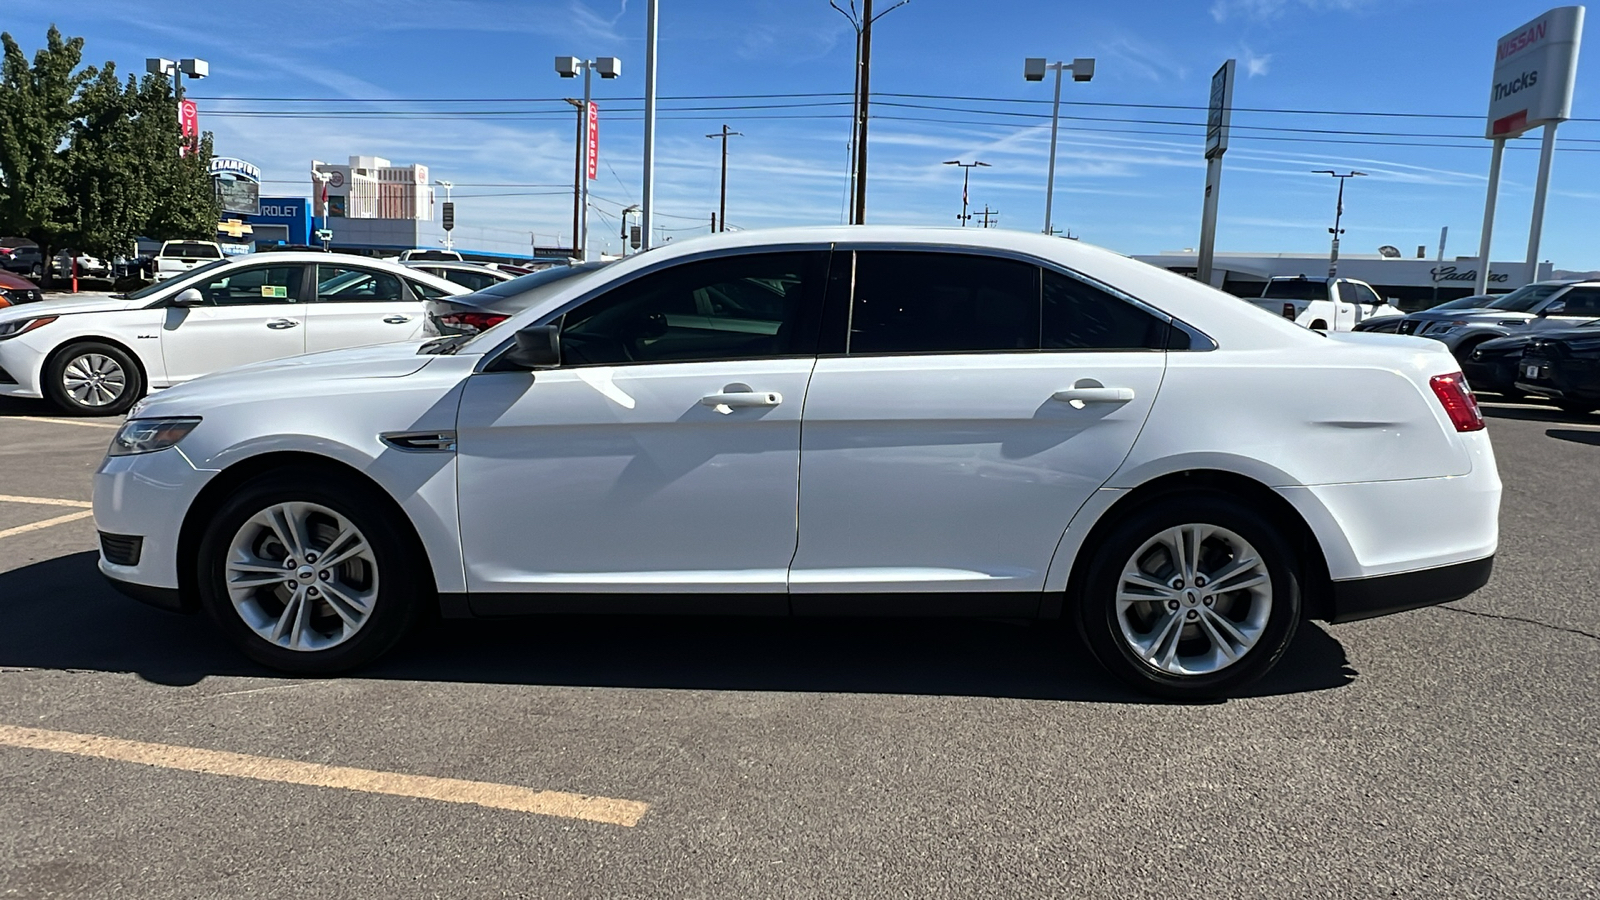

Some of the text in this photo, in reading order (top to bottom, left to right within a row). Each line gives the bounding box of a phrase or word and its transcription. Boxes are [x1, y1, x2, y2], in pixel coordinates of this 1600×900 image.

[1498, 20, 1547, 60] NISSAN
[1494, 71, 1538, 101] Trucks
[211, 160, 259, 177] CHAMPION
[1430, 266, 1509, 282] Cadiac
